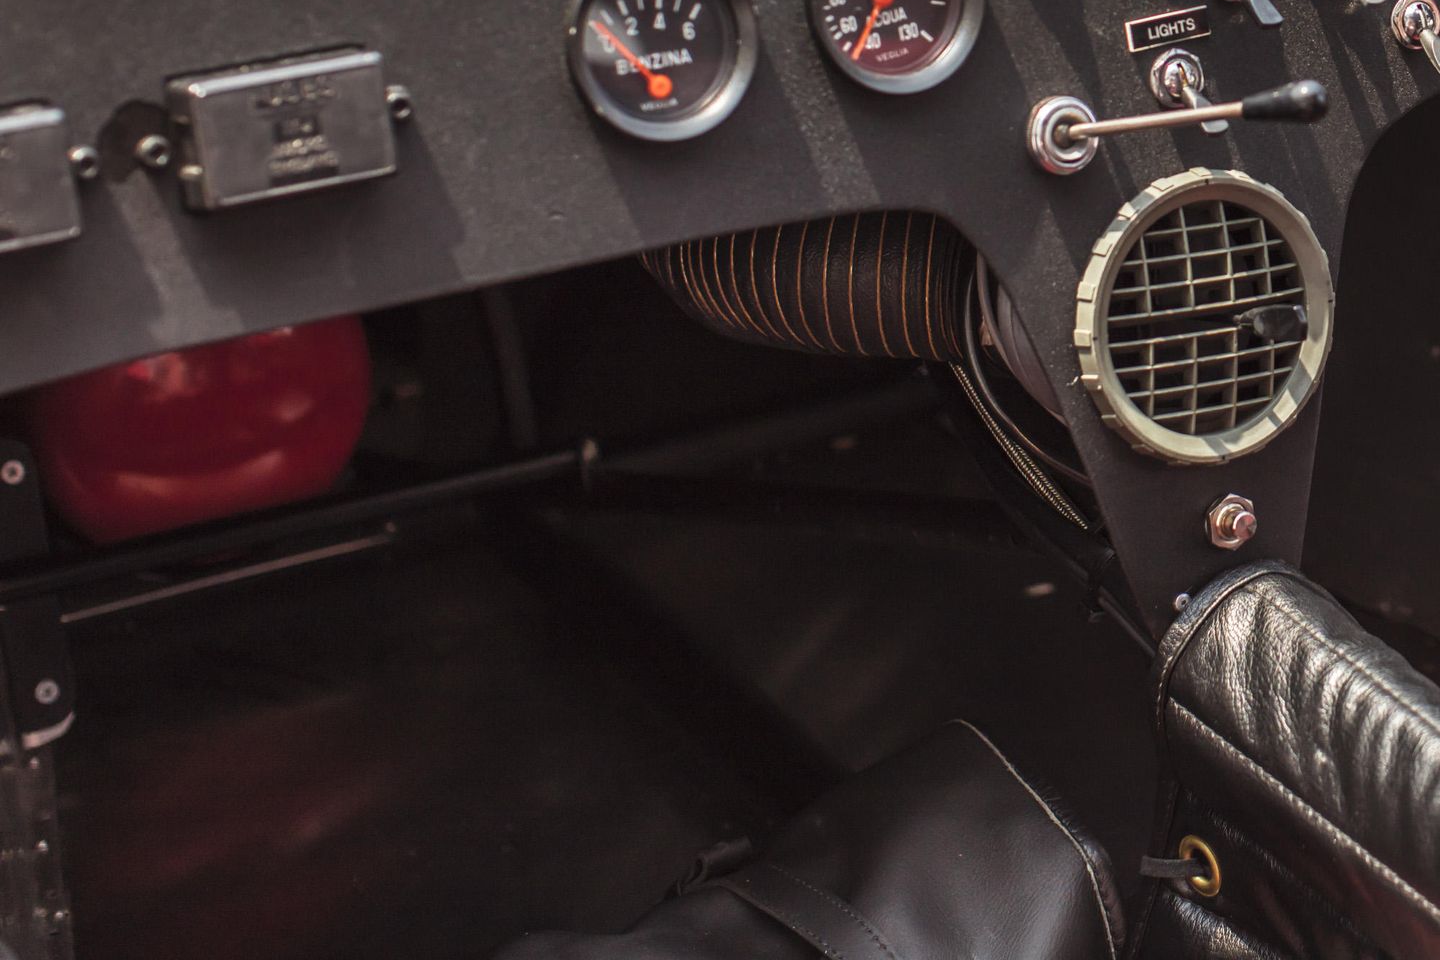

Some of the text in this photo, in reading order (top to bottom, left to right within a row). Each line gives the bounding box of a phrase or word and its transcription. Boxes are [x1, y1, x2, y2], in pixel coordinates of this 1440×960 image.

[624, 16, 639, 36] 2
[653, 12, 666, 31] 4
[682, 21, 696, 41] 6
[839, 15, 858, 34] 60
[1147, 18, 1196, 40] LIGHTS
[898, 22, 920, 41] 130
